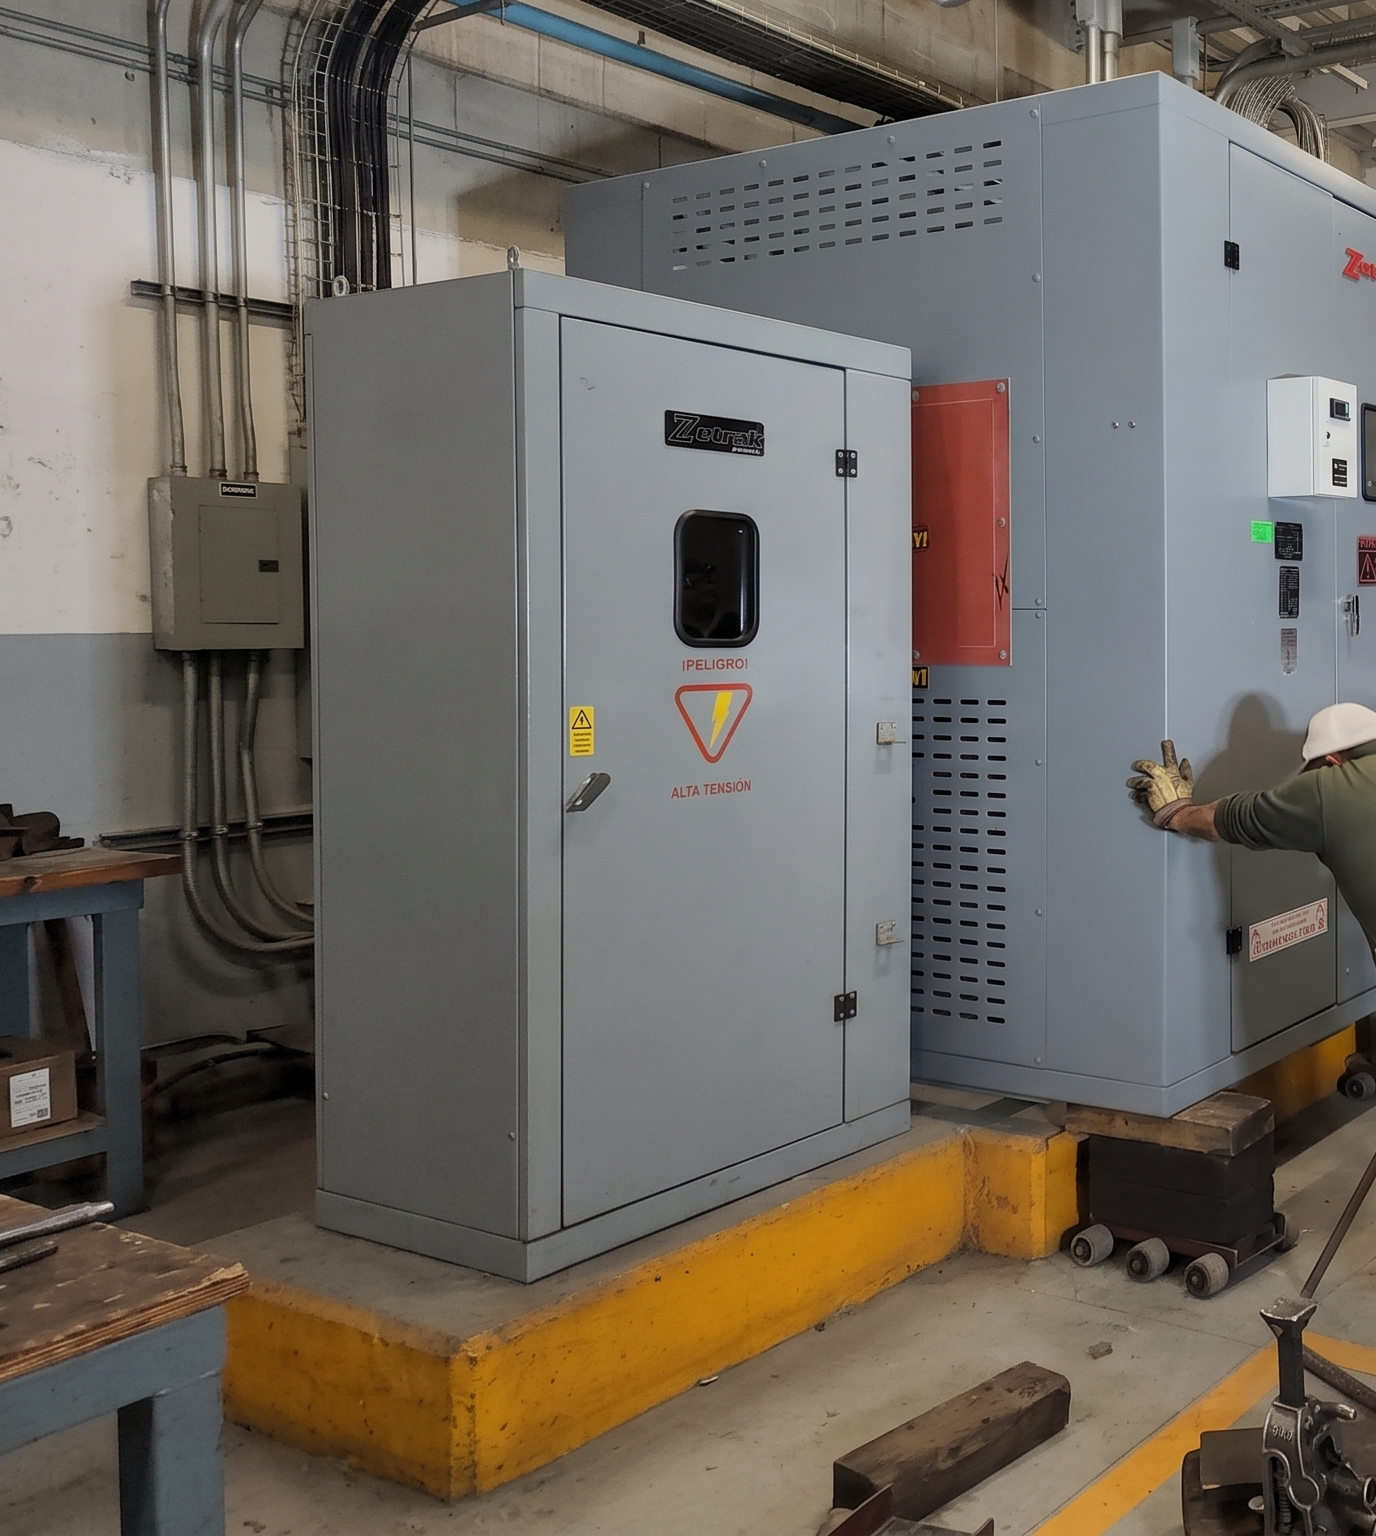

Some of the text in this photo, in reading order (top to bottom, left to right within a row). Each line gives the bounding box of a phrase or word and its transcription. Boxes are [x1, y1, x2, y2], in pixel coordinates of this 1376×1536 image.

[668, 413, 765, 449] Zetrak
[671, 778, 751, 799] ALTA TENSIÓN
